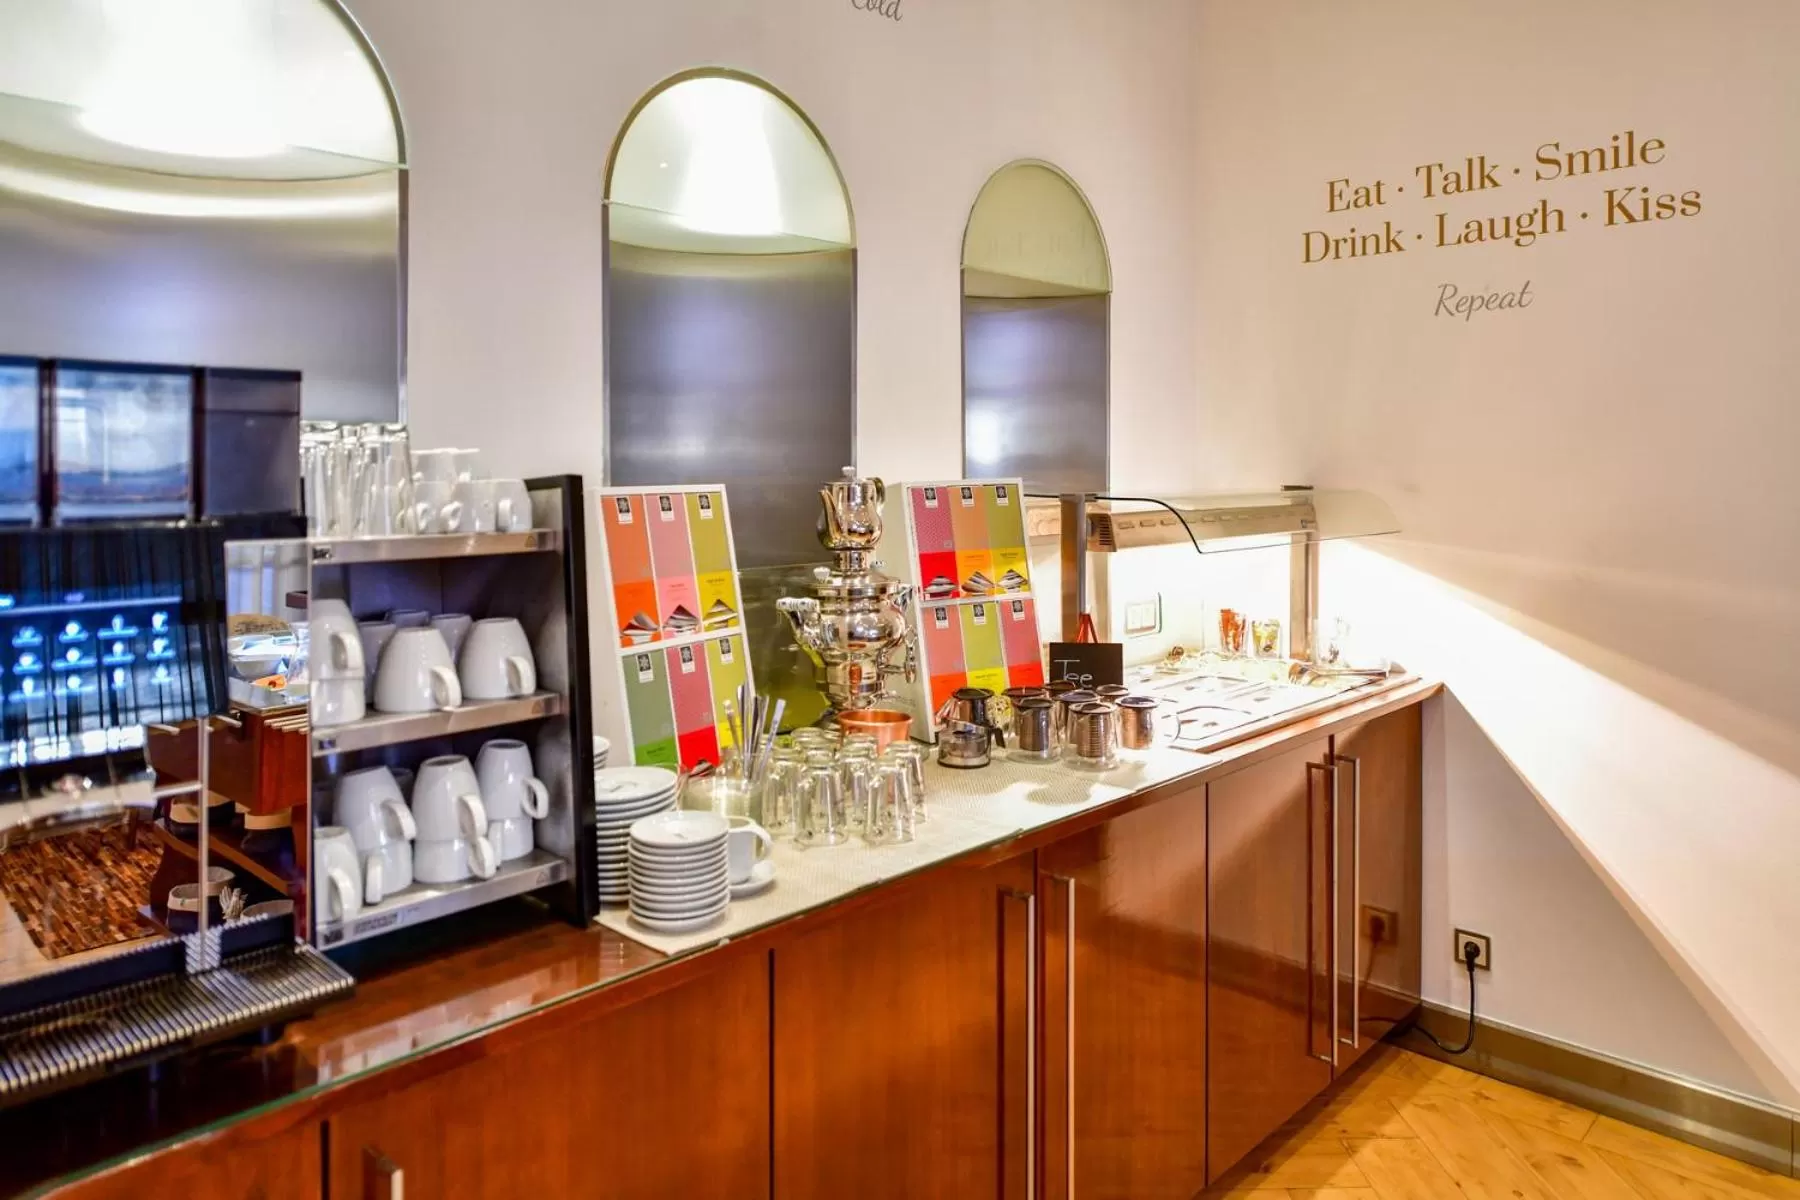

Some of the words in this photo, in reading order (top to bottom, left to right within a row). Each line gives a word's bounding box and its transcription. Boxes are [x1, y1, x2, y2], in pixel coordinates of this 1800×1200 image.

[1326, 178, 1387, 213] Eat
[1415, 156, 1501, 199] Talk
[1535, 130, 1666, 182] Smile
[1302, 220, 1406, 264] Drink
[1435, 200, 1566, 248] Laugh
[1603, 186, 1702, 227] Kiss
[1434, 280, 1533, 322] Repeat
